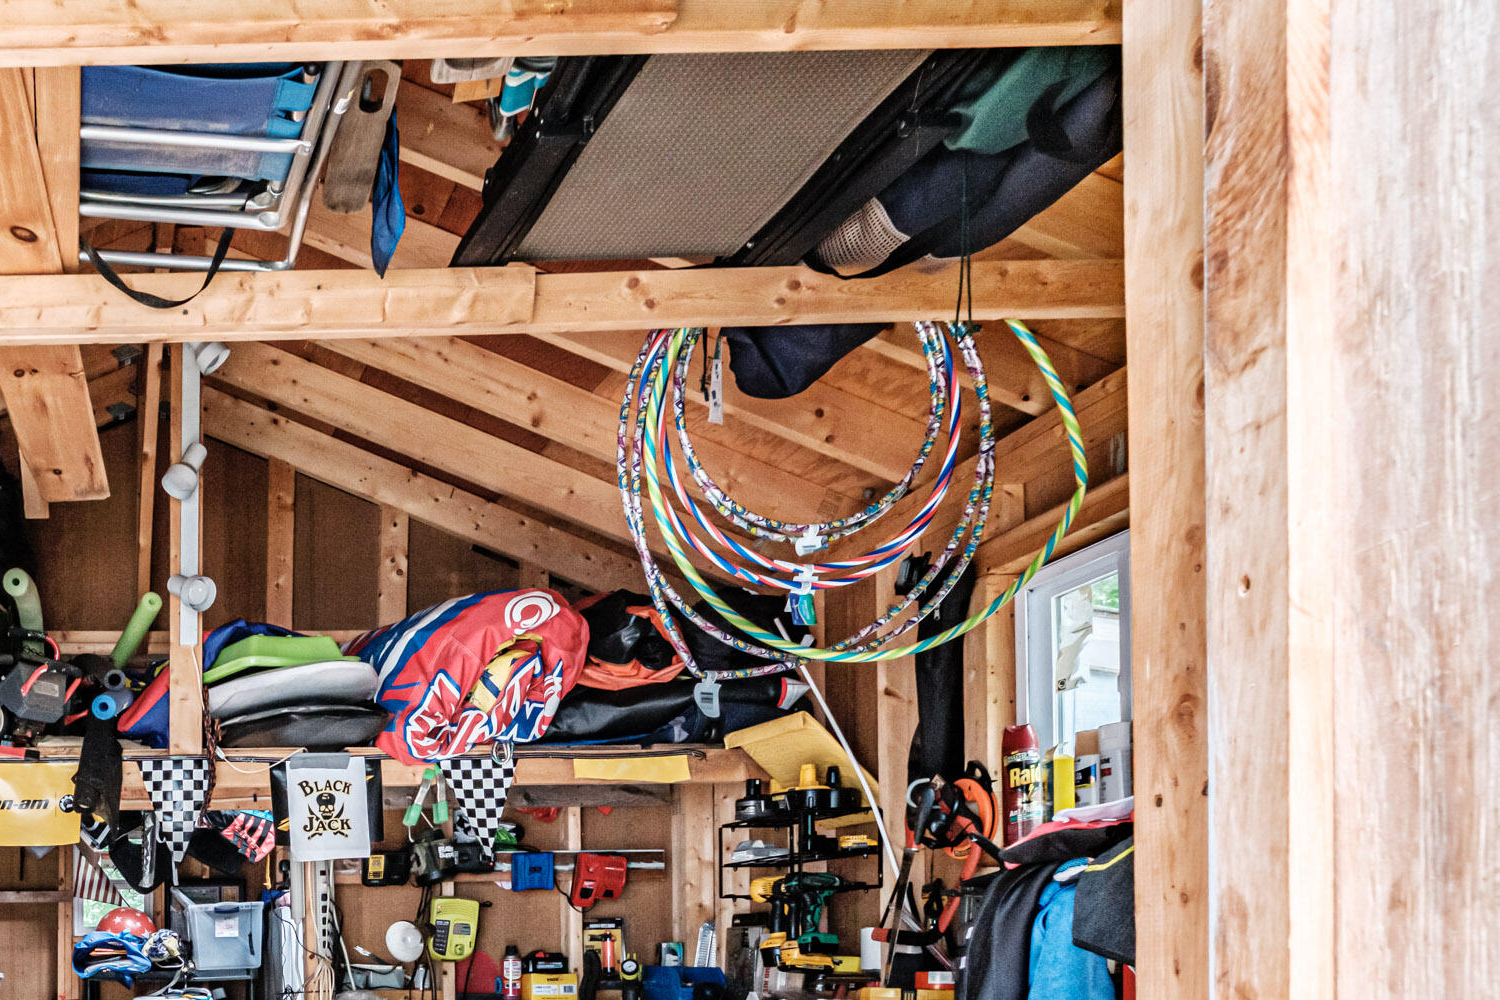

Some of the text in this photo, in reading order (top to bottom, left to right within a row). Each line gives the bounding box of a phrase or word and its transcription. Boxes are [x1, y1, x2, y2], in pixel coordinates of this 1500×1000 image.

[1009, 762, 1042, 789] Raid
[297, 779, 352, 797] BLACK
[303, 816, 352, 832] JACK
